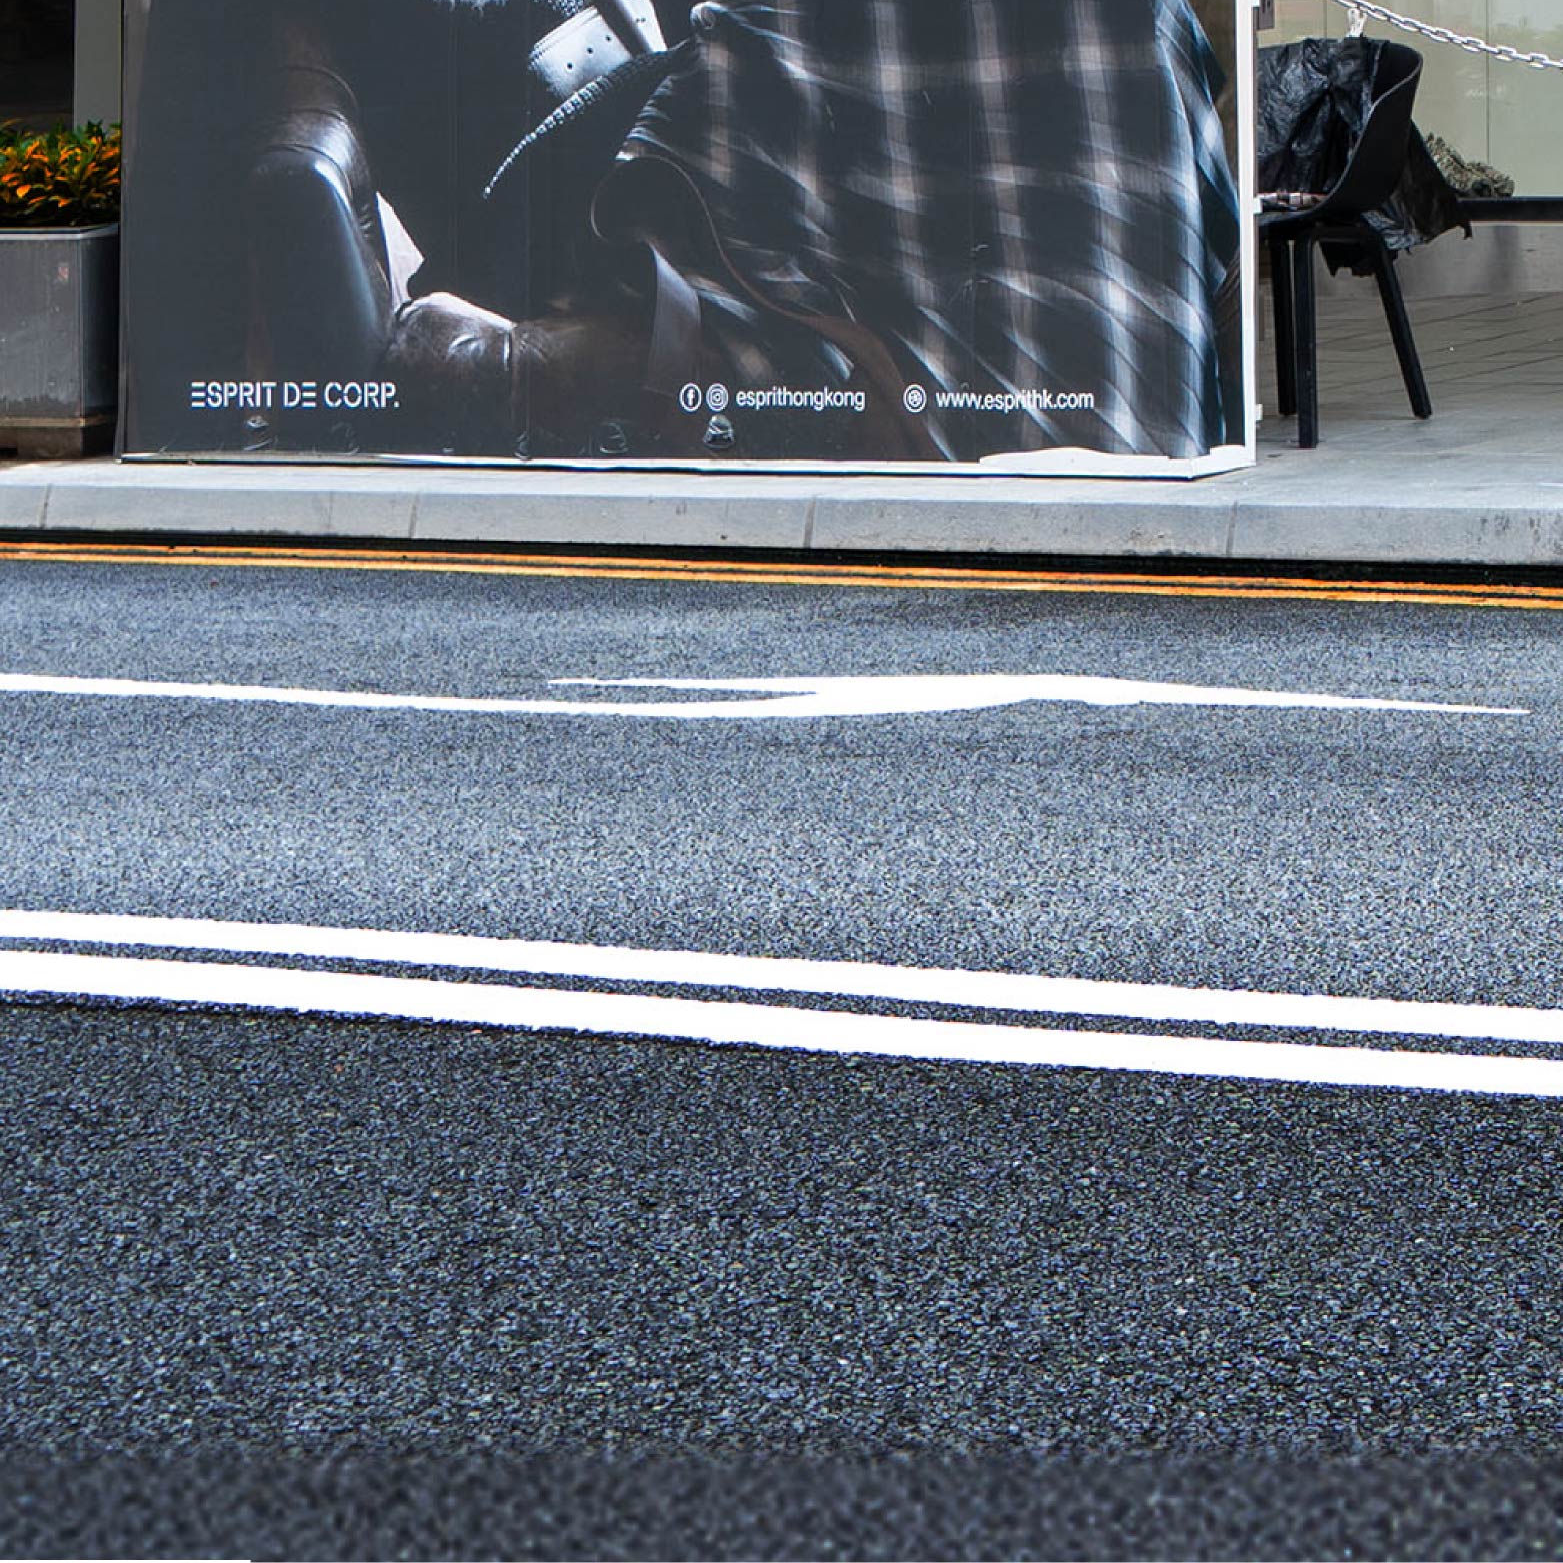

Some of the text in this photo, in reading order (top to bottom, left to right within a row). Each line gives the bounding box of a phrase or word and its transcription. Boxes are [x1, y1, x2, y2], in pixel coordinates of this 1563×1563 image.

[191, 381, 400, 409] ESPRIT DE CORP.
[736, 386, 866, 412] esprithongkong
[935, 388, 1096, 411] www.esprithk.com
